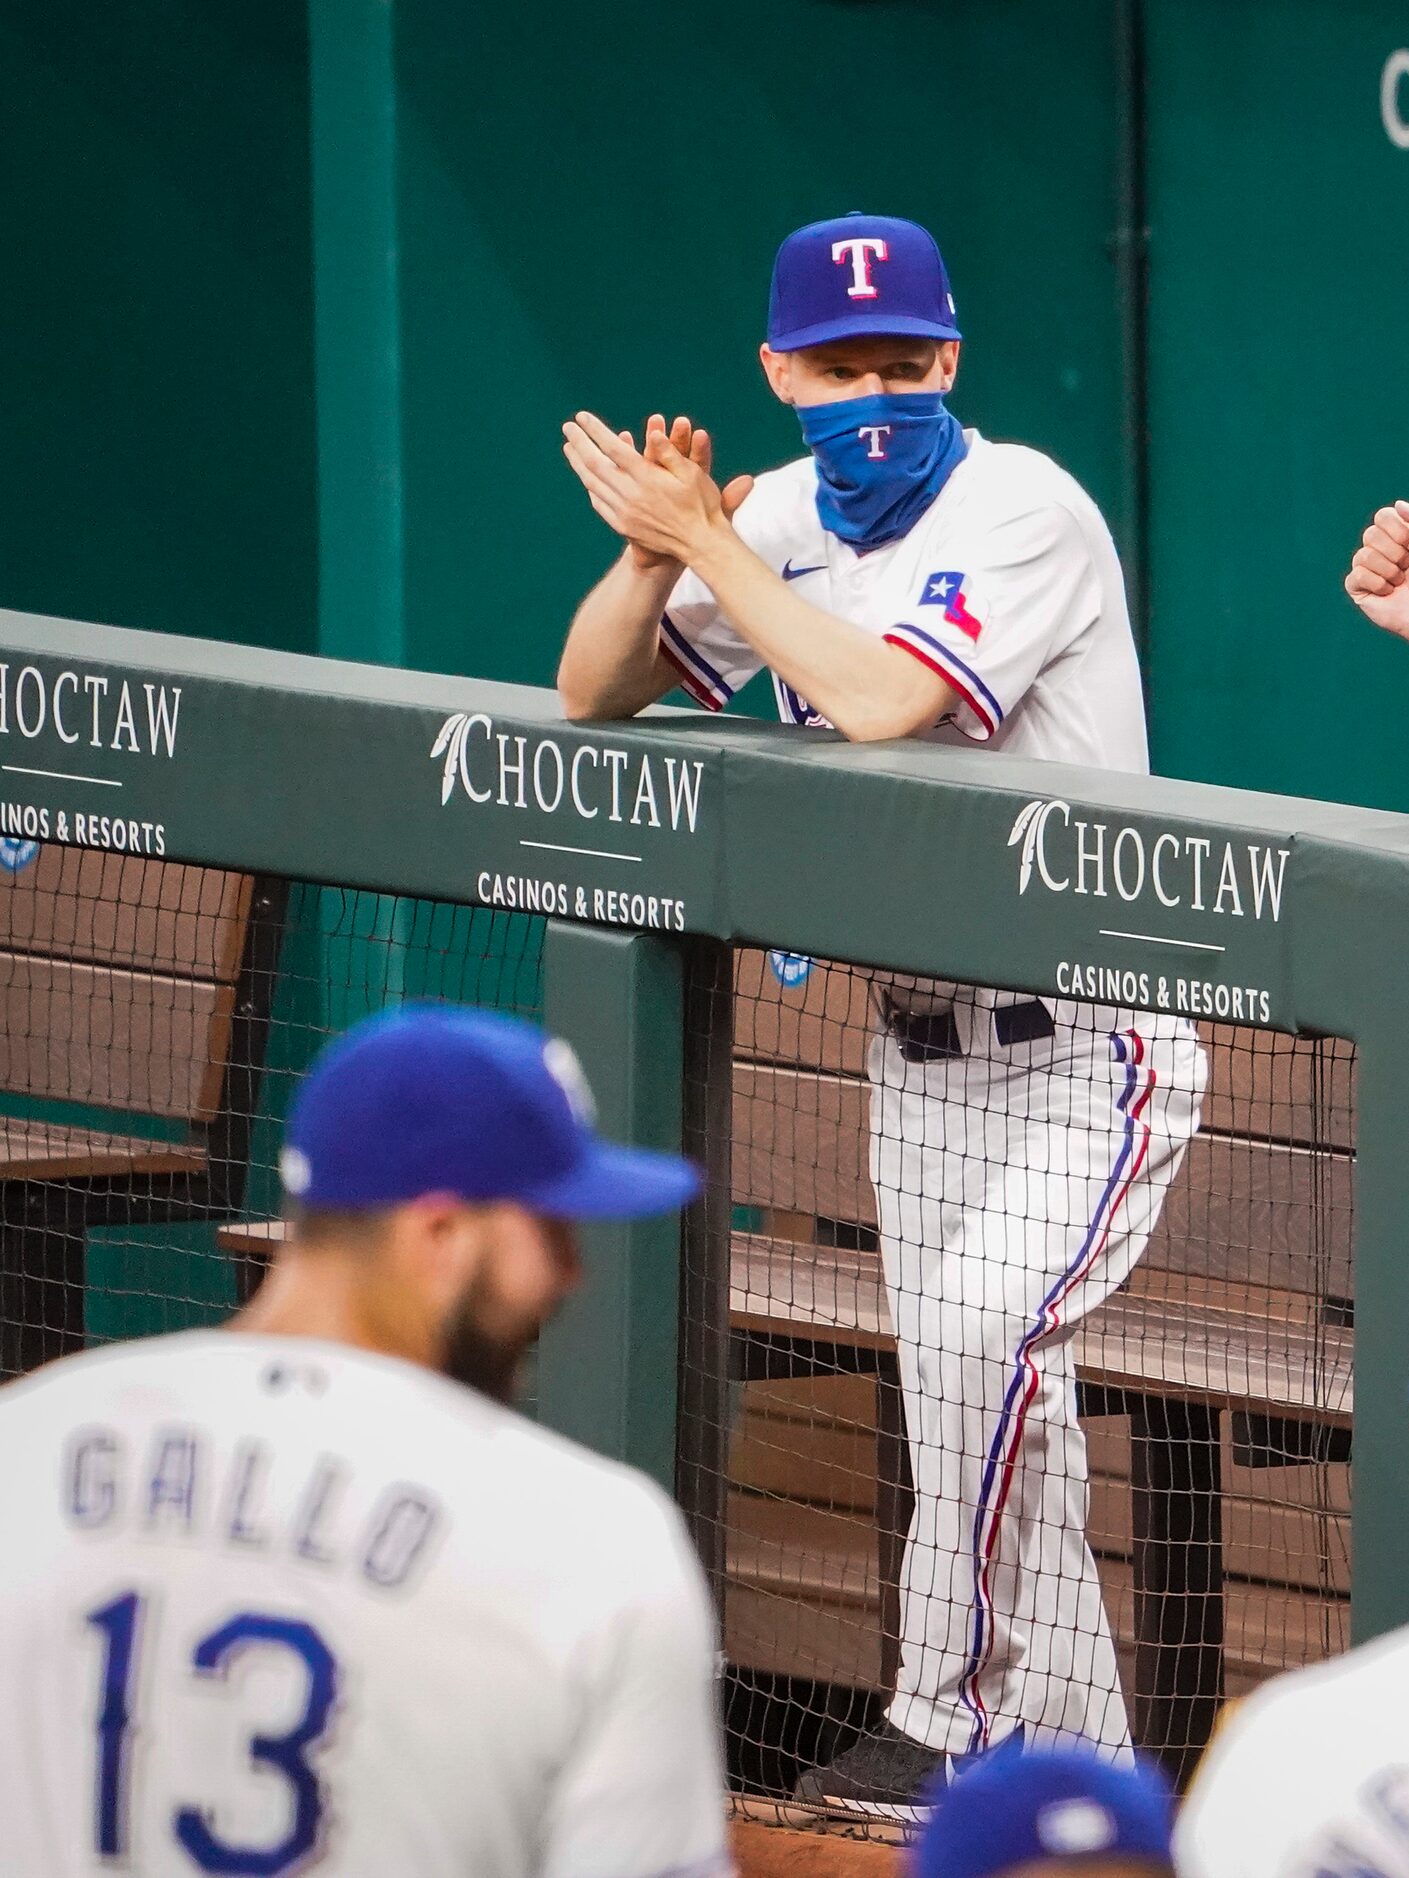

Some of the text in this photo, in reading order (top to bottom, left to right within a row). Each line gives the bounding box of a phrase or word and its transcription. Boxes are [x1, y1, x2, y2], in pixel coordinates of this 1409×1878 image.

[831, 238, 889, 300] T
[858, 424, 892, 461] T
[459, 713, 706, 835] CHOCTAW
[55, 809, 71, 844] &
[74, 811, 166, 857] RESORTS
[1036, 801, 1292, 924] CHOCTAW
[476, 870, 686, 933] CASINOS & RESORTS
[1055, 960, 1271, 1024] CASINOS & RESORTS
[64, 1426, 444, 1598] GALLO
[86, 1588, 342, 1876] 13
